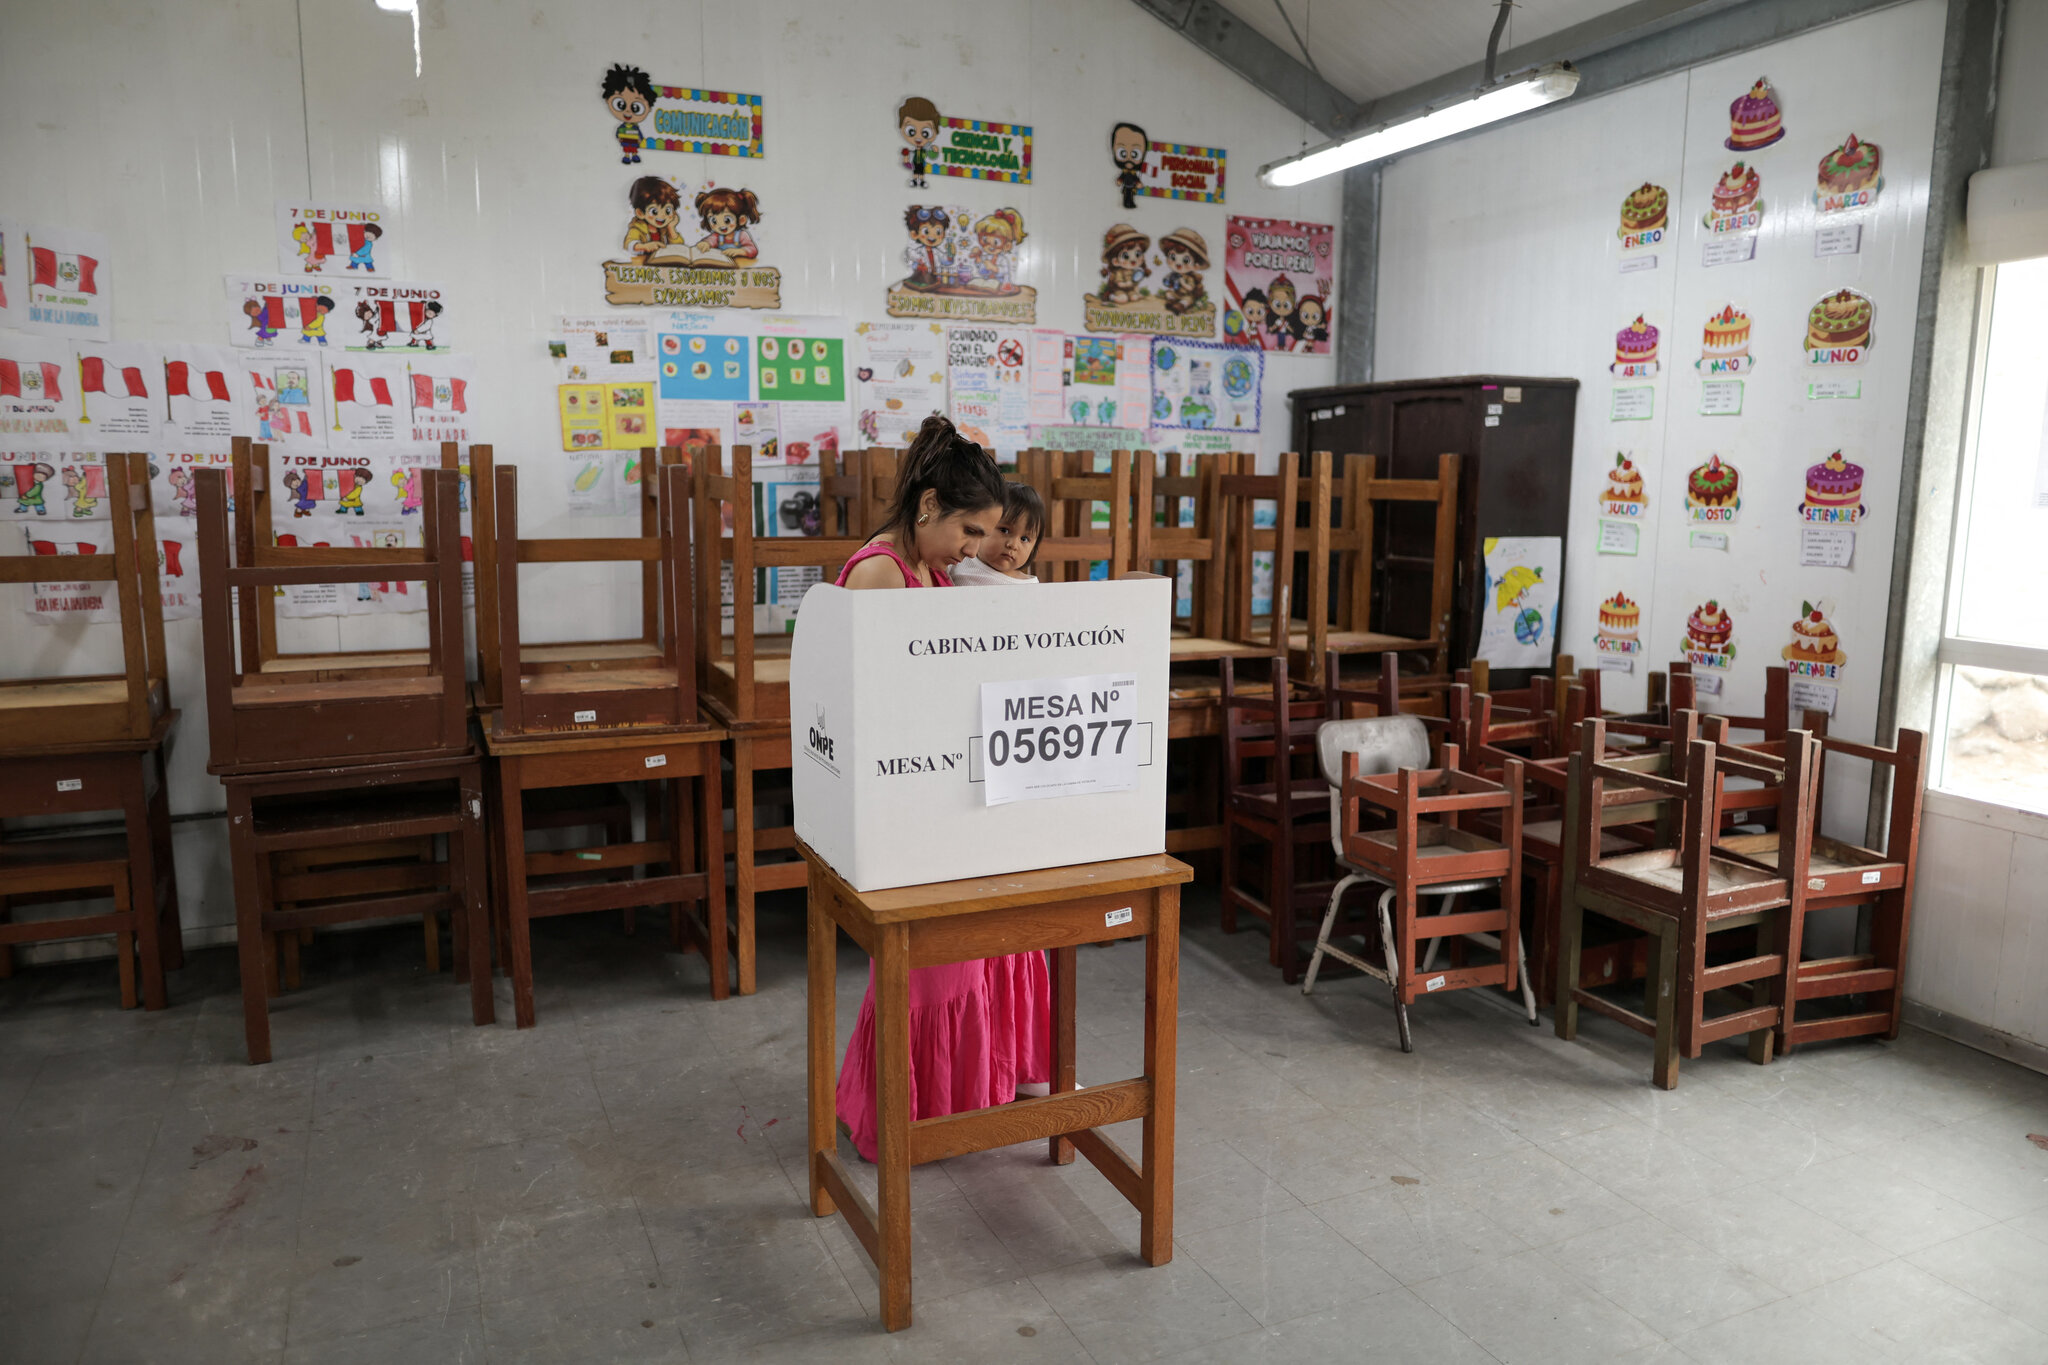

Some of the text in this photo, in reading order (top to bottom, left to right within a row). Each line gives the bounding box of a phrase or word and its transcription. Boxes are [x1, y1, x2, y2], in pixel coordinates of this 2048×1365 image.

[654, 108, 750, 140] COMUNICACIÓN
[951, 131, 1012, 152] CIENCIA Y
[942, 147, 1020, 171] TECNOLOGÍA
[1161, 155, 1216, 174] PERSONAL
[1171, 173, 1207, 190] SOCIAL
[1825, 192, 1869, 211] MARZO
[290, 209, 380, 222] 7 DE JUNIO
[1714, 213, 1756, 232] FEBRERO
[1625, 230, 1661, 248] ENERO
[1245, 253, 1315, 274] POR EL PERÚ
[240, 282, 332, 295] 7 DE JUNIO
[354, 287, 441, 299] 7 DE JUNIO
[38, 294, 43, 302] 7
[59, 296, 88, 306] JUNIO
[1812, 349, 1858, 363] JUNIO
[1623, 365, 1647, 377] ABRIL
[1711, 359, 1739, 372] MAYO
[0, 451, 51, 462] UNIO
[71, 452, 96, 462] DE
[167, 453, 176, 463] 7
[181, 454, 204, 463] DE
[282, 456, 371, 468] 7 DE JUNIO
[401, 456, 421, 465] DE
[1608, 503, 1638, 515] JULIO
[1693, 509, 1732, 521] AGOSTO
[1805, 509, 1857, 523] SETIEMBRE
[908, 625, 1126, 657] CABINA DE VOTACIÓN
[1600, 639, 1636, 654] OCTUBRE
[1687, 651, 1728, 669] NOVIEMBRE
[1789, 661, 1836, 679] DICIEMBRE
[1004, 694, 1084, 721] MESA
[809, 726, 834, 762] ONPE
[988, 719, 1133, 767] 056977
[876, 756, 936, 777] MESA
